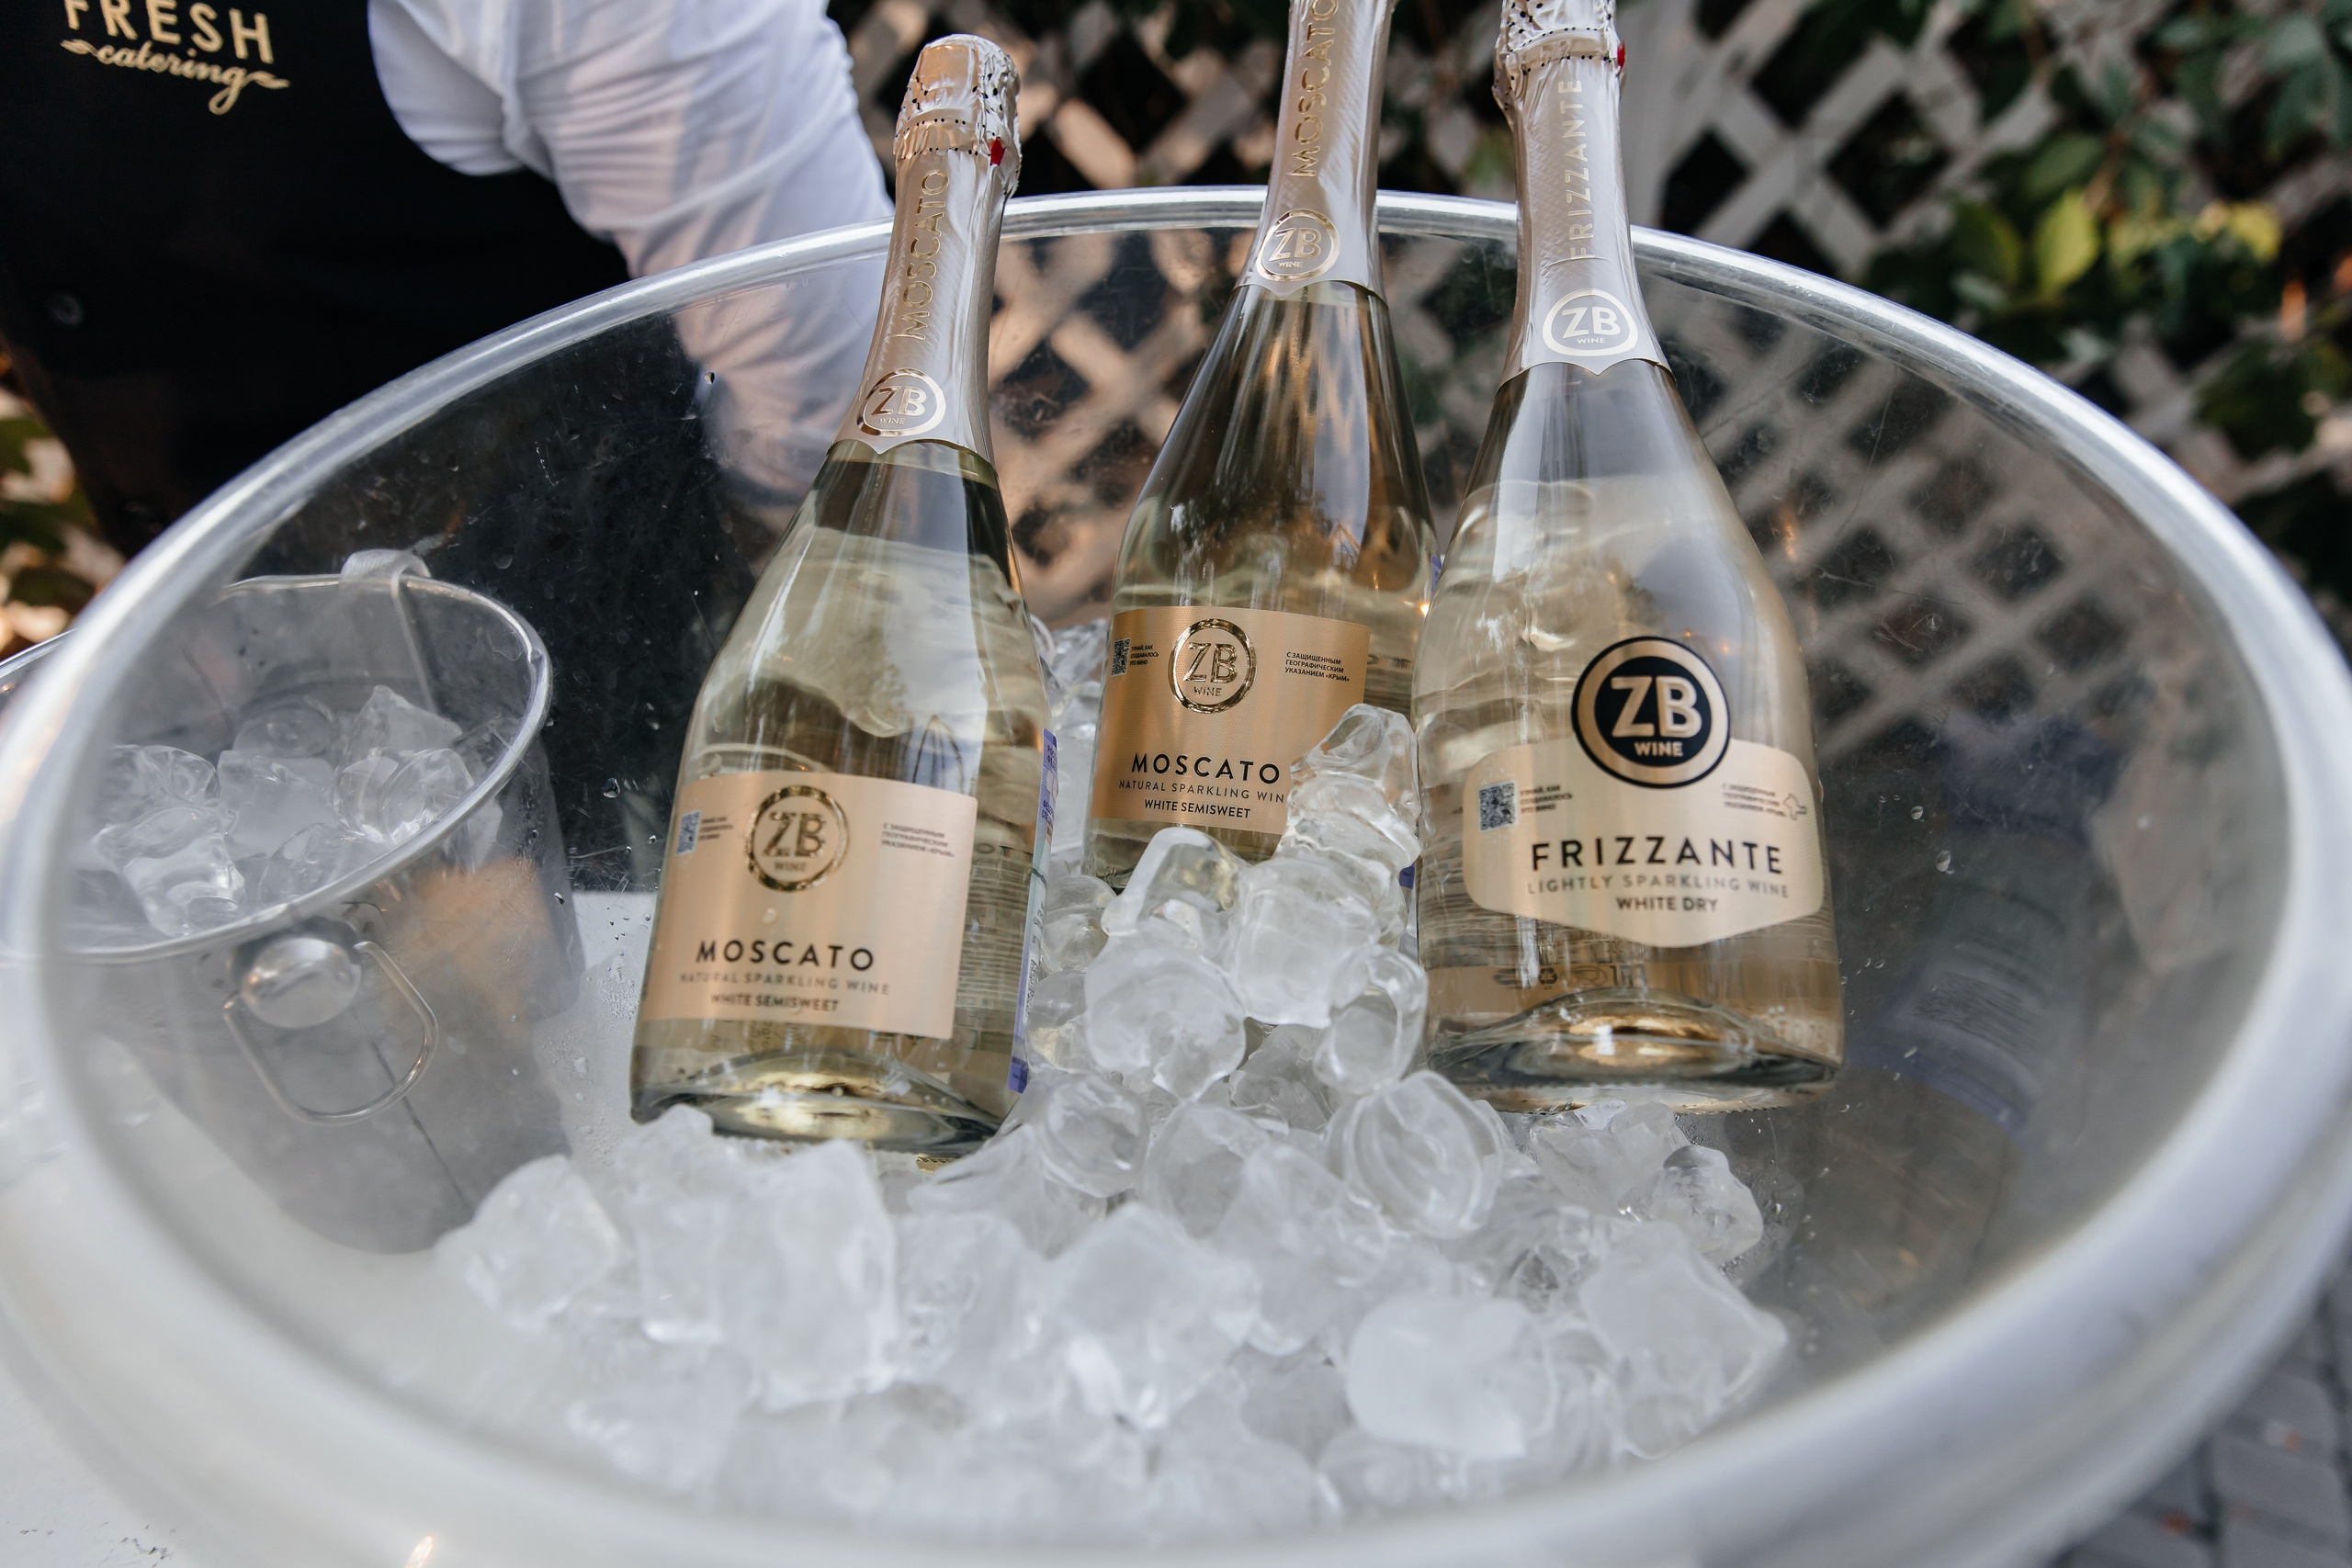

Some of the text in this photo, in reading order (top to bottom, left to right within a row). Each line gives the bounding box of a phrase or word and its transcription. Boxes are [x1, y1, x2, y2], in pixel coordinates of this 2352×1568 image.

[62, 0, 274, 64] FRESH
[60, 39, 291, 115] catering
[1291, 0, 1340, 178] MOSCATO
[1557, 79, 1596, 261] FRIZZANTE
[896, 168, 950, 341] MOSCATO
[1269, 227, 1322, 262] ZB
[1278, 261, 1304, 269] WINE
[1562, 306, 1622, 339] ZB
[871, 386, 928, 416] ZB
[879, 417, 906, 425] WINE
[1182, 641, 1238, 684] ZB
[1284, 667, 1325, 678] УКАЗАНИЕМ
[1285, 659, 1344, 673] ГЕОГРАФИЧЕСКИМ
[1292, 652, 1341, 665] ЗАЩИЩЕННЫМ
[1193, 686, 1222, 697] WINE
[1610, 675, 1703, 739] ZB
[1634, 740, 1684, 758] WINE
[1131, 752, 1280, 784] MOSCATO
[1118, 780, 1285, 804] NATURAL SPARKLING WIN
[1144, 799, 1251, 818] WHITE SEMISWEET
[763, 811, 826, 858] ZB
[1531, 836, 1783, 874] FRIZZANTE
[1527, 874, 1790, 898] LIGHTLY SPARKLING WINE
[1616, 896, 1719, 913] WHITE DRY
[695, 940, 875, 972] MOSCATO
[679, 972, 891, 996] NATURAL SPARKLING WINE
[710, 993, 841, 1012] WHITE SEMISWEET
